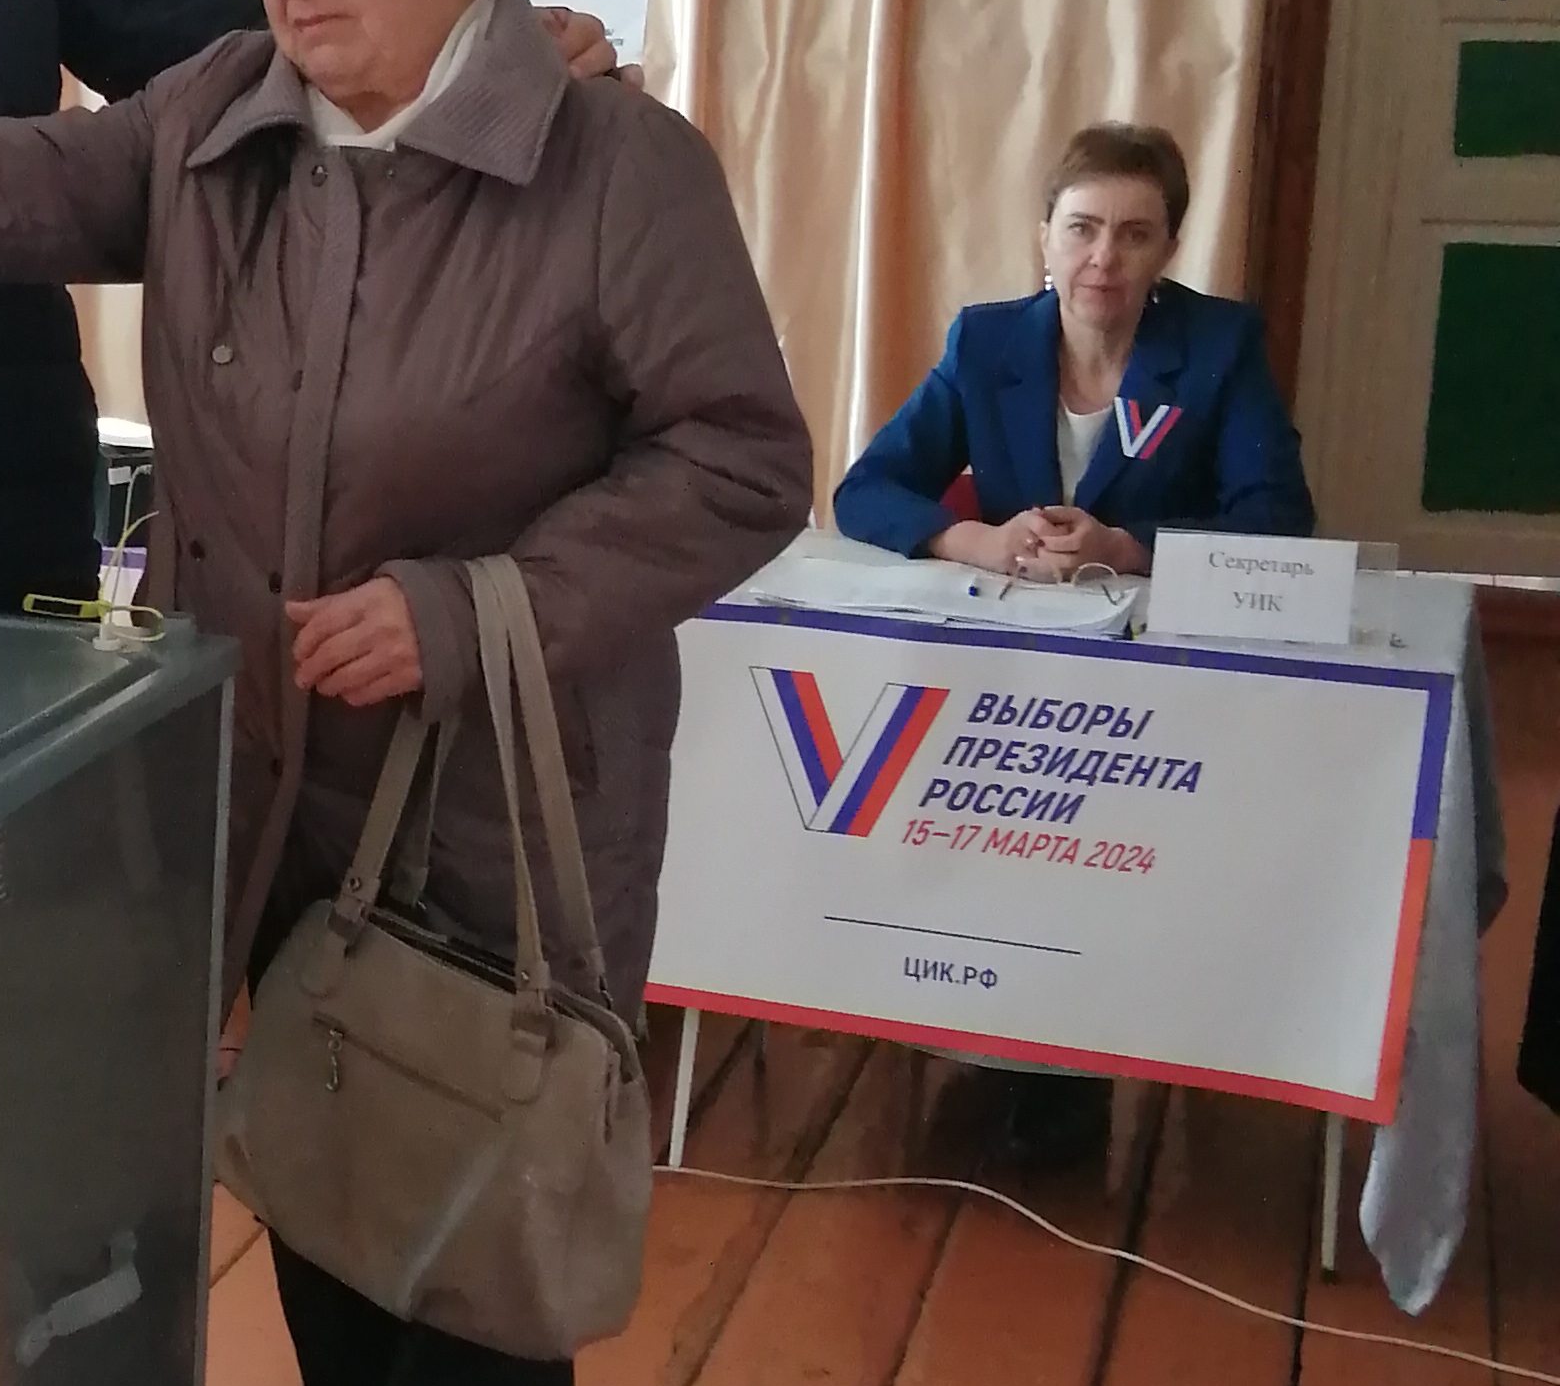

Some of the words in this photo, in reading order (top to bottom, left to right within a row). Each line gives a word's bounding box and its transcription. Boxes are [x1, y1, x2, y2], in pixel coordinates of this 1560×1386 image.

[1208, 550, 1315, 578] Секретарь
[1233, 590, 1283, 613] УИК
[967, 691, 1154, 740] ВЫБОРЫ
[942, 735, 1203, 793] ПРЕЗИДЕНТА
[918, 778, 1086, 824] РОССИИ
[981, 826, 1081, 865] МАРТА
[1083, 841, 1156, 874] 2024
[904, 956, 998, 989] ЦИК.РФ
